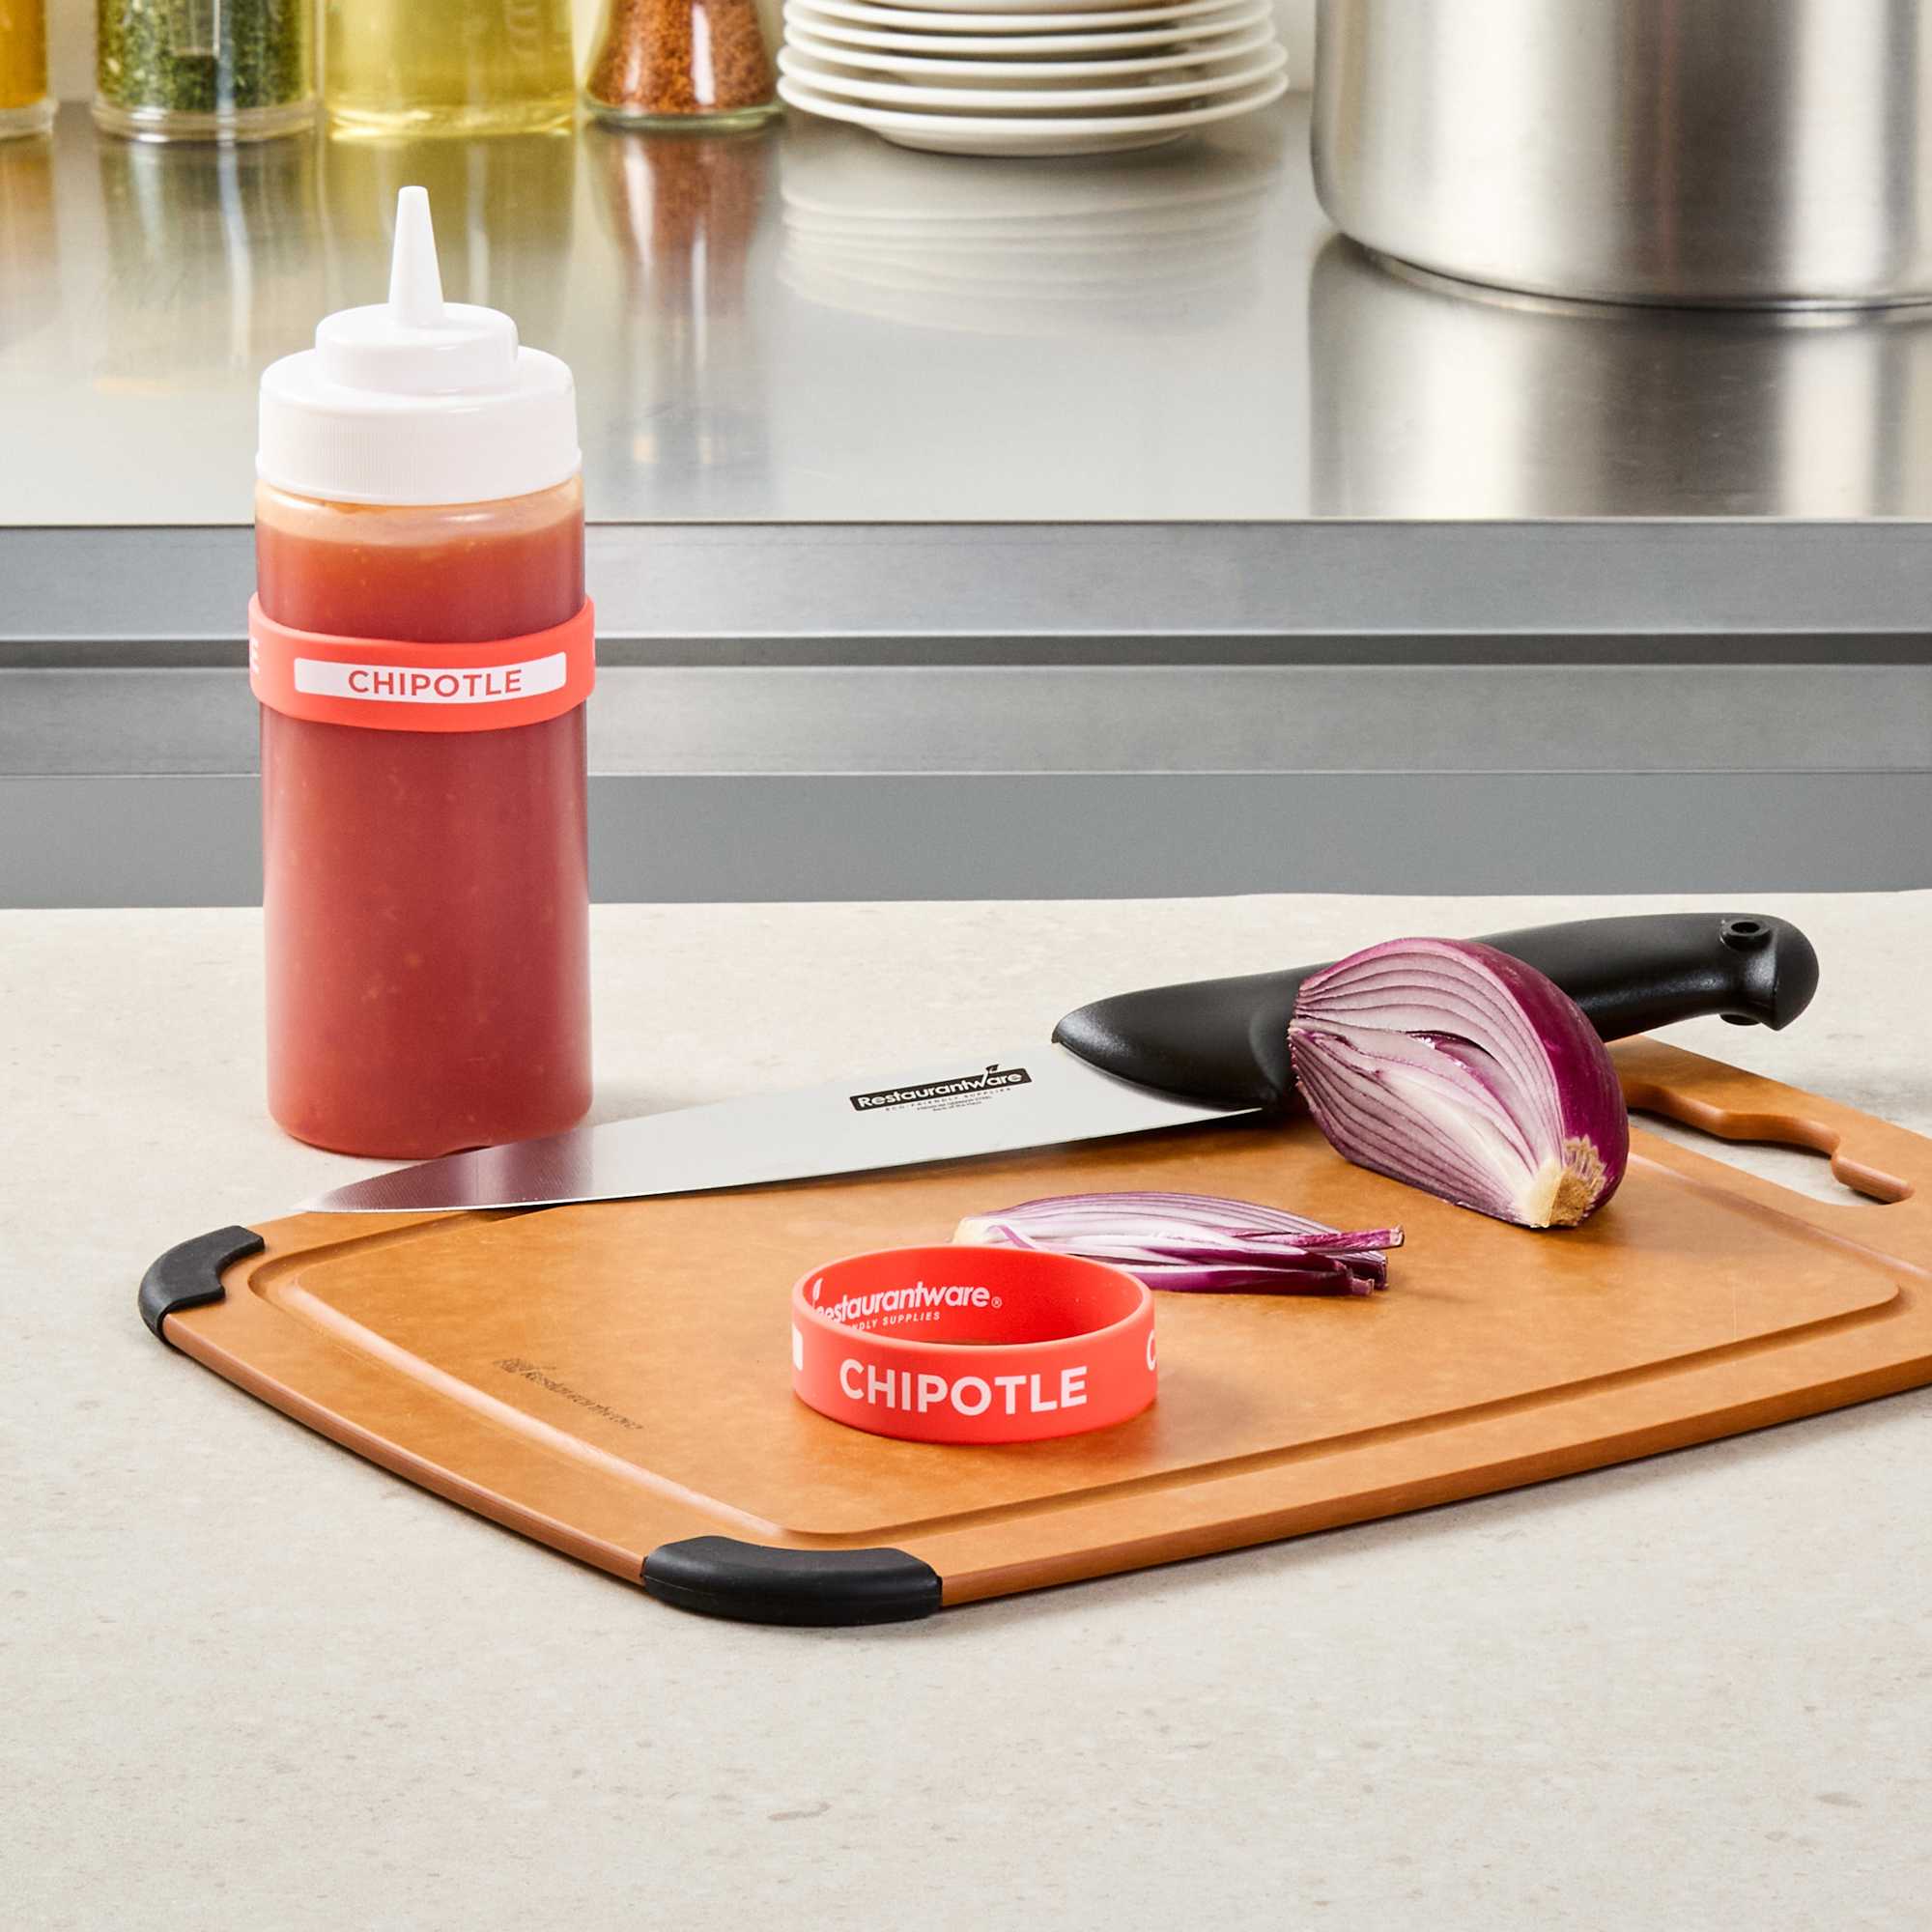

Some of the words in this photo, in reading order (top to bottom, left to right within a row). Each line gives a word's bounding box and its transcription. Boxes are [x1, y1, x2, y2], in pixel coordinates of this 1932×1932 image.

[348, 668, 523, 697] CHIPOTLE
[858, 1069, 1023, 1108] Restaurantware
[882, 1311, 941, 1326] SUPPLIES
[839, 1358, 1088, 1416] CHIPOTLE
